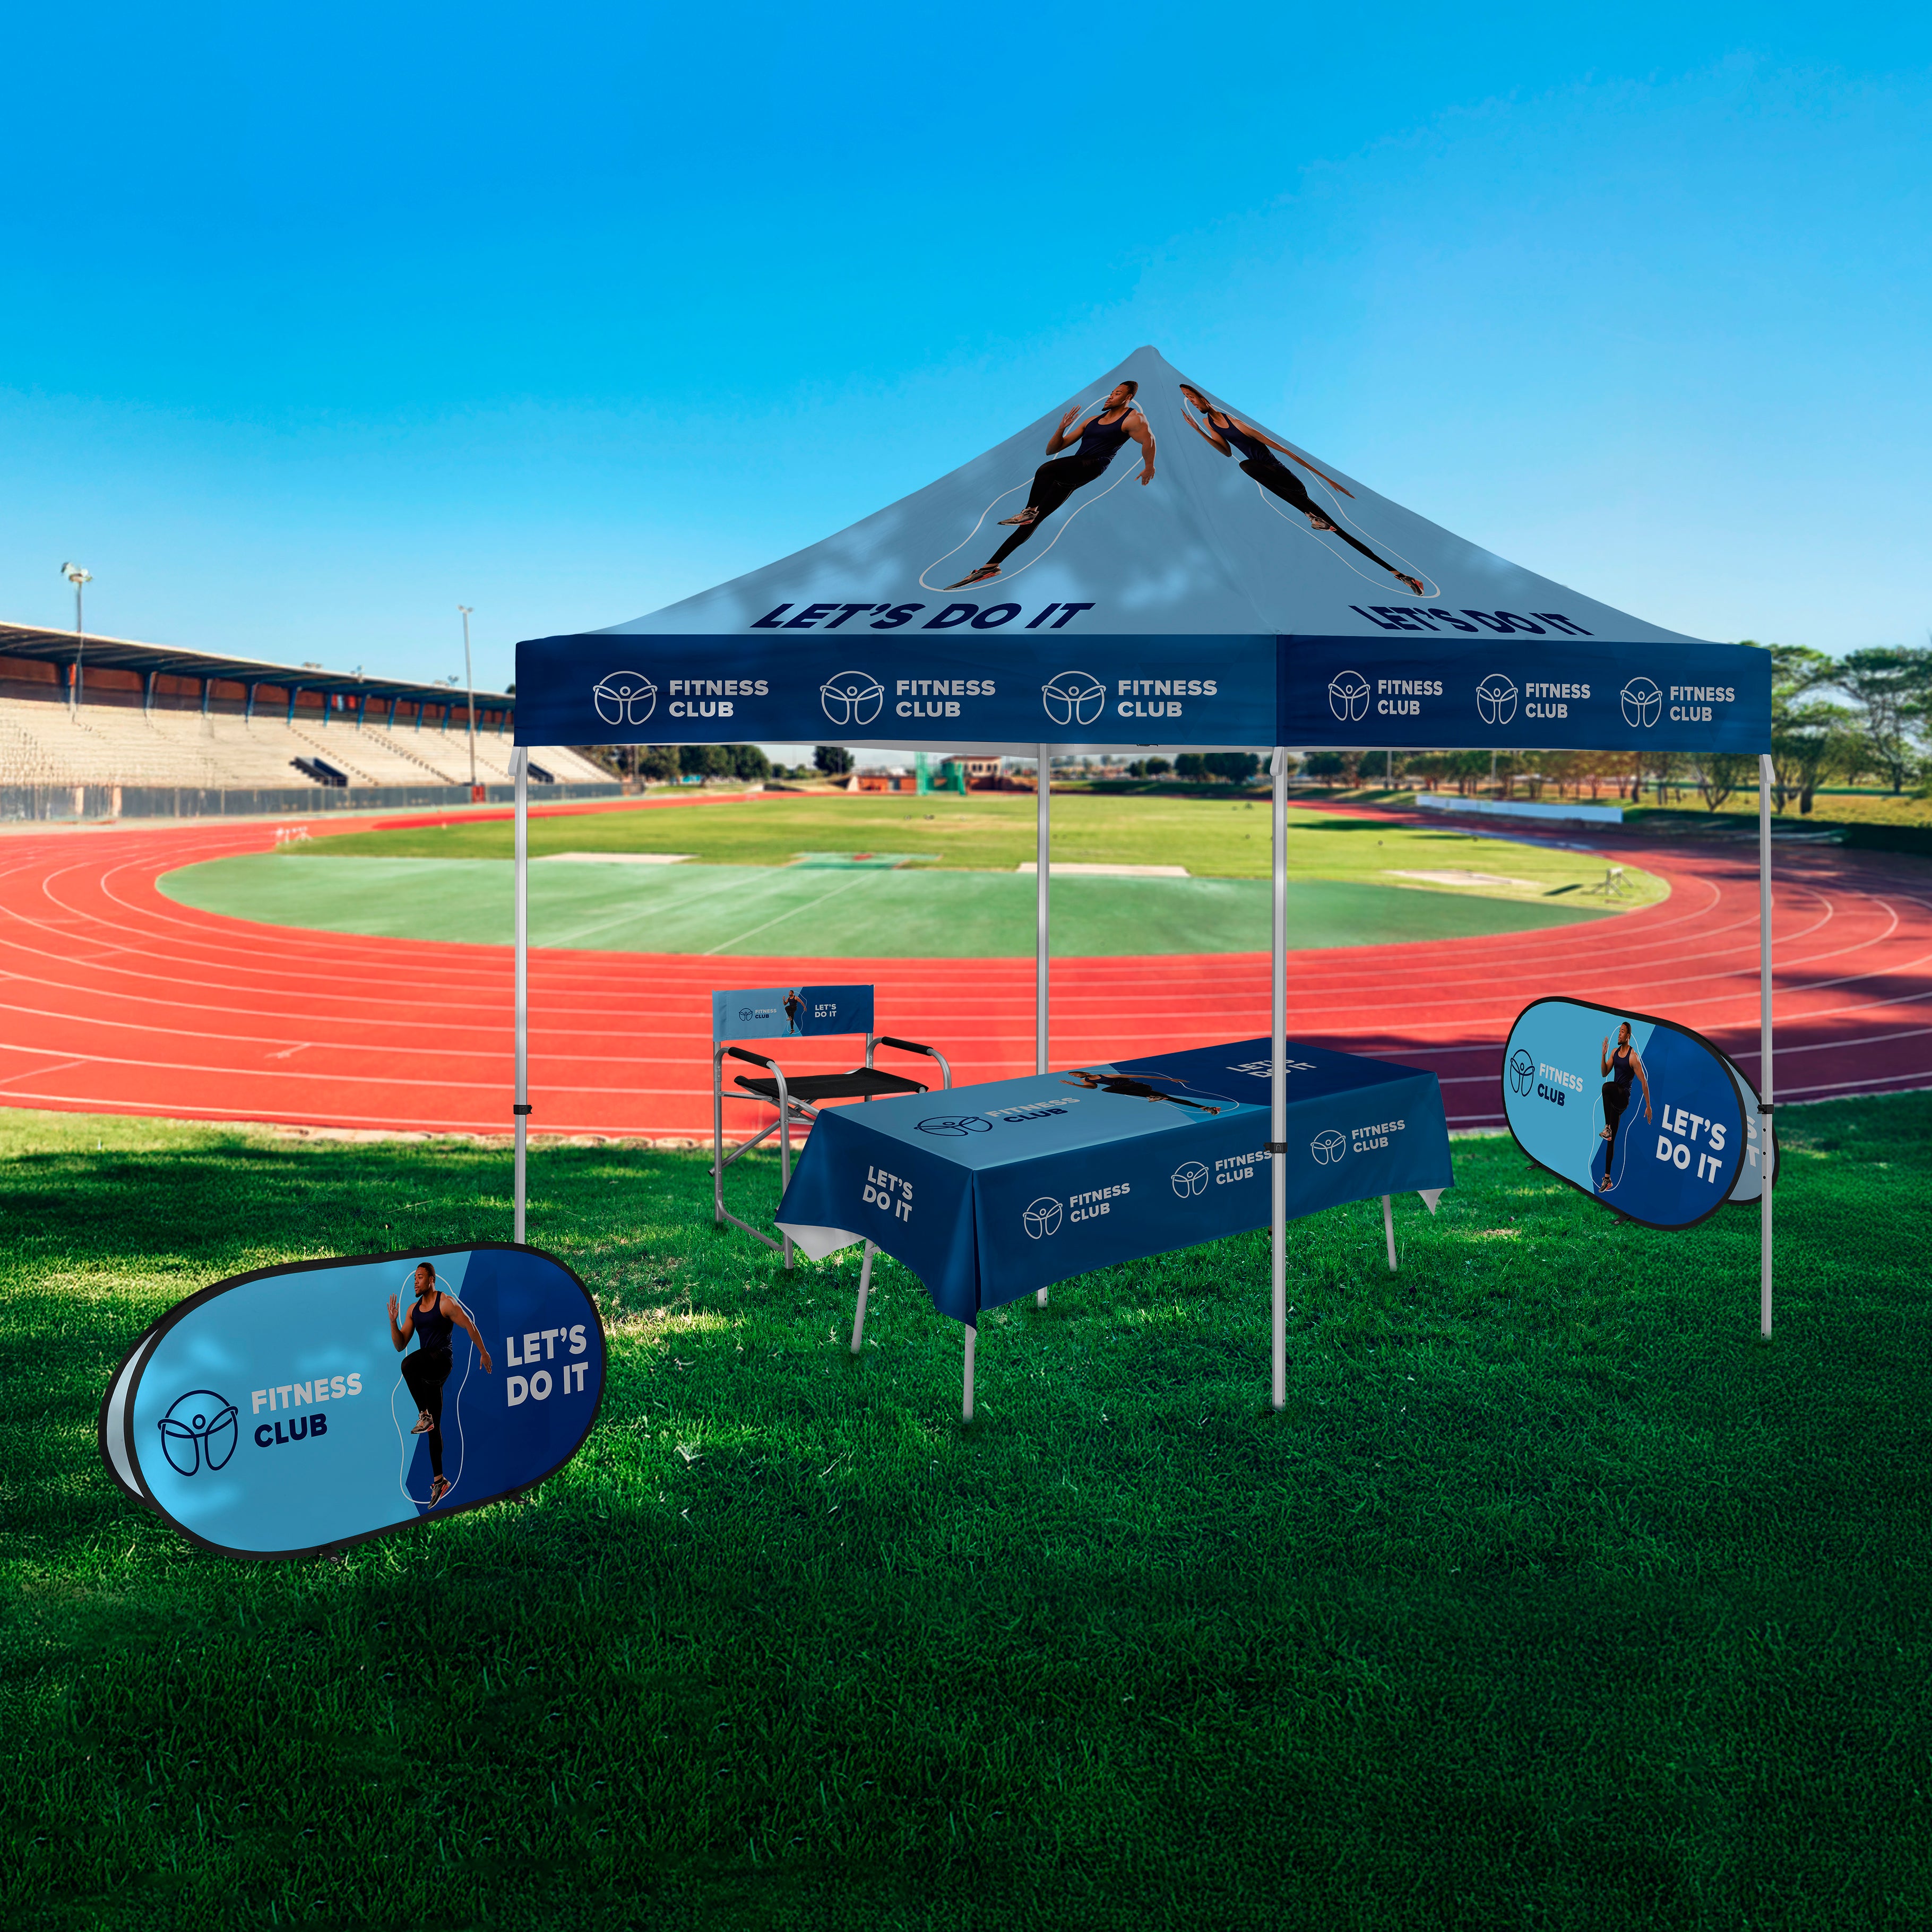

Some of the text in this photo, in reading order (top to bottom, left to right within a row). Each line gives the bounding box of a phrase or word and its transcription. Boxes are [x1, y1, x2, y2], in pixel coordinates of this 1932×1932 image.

[749, 603, 1096, 629] LET'S DO IT
[1348, 605, 1595, 636] LET'S DO IT
[670, 680, 769, 696] FITNESS
[897, 680, 996, 696] FITNESS
[1119, 680, 1218, 696] FITNESS
[1378, 679, 1443, 696] FITNESS
[1526, 683, 1591, 699] FITNESS
[1670, 686, 1735, 702] FITNESS
[669, 701, 734, 717] CLUB
[896, 701, 961, 717] CLUB
[1118, 701, 1182, 717] CLUB
[1378, 700, 1420, 715] CLUB
[1526, 703, 1568, 718] CLUB
[1670, 706, 1712, 721] CLUB
[1540, 1063, 1583, 1093] FITNESS
[1537, 1083, 1565, 1107] CLUB
[984, 1097, 1081, 1117] FITNESS
[1003, 1108, 1068, 1122] CLUB
[1352, 1119, 1405, 1140] FITNESS
[1661, 1104, 1727, 1151] LET'S
[1353, 1136, 1388, 1152] CLUB
[1215, 1150, 1272, 1171] FITNESS
[1656, 1135, 1722, 1184] DO IT
[867, 1166, 913, 1200] LET'S
[1216, 1167, 1254, 1184] CLUB
[862, 1184, 912, 1222] DO IT
[1070, 1183, 1130, 1208] FITNESS
[1070, 1202, 1110, 1222] CLUB
[506, 1325, 586, 1367] LET'S
[251, 1373, 363, 1414] FITNESS
[507, 1362, 589, 1407] DO IT
[254, 1413, 327, 1448] CLUB
